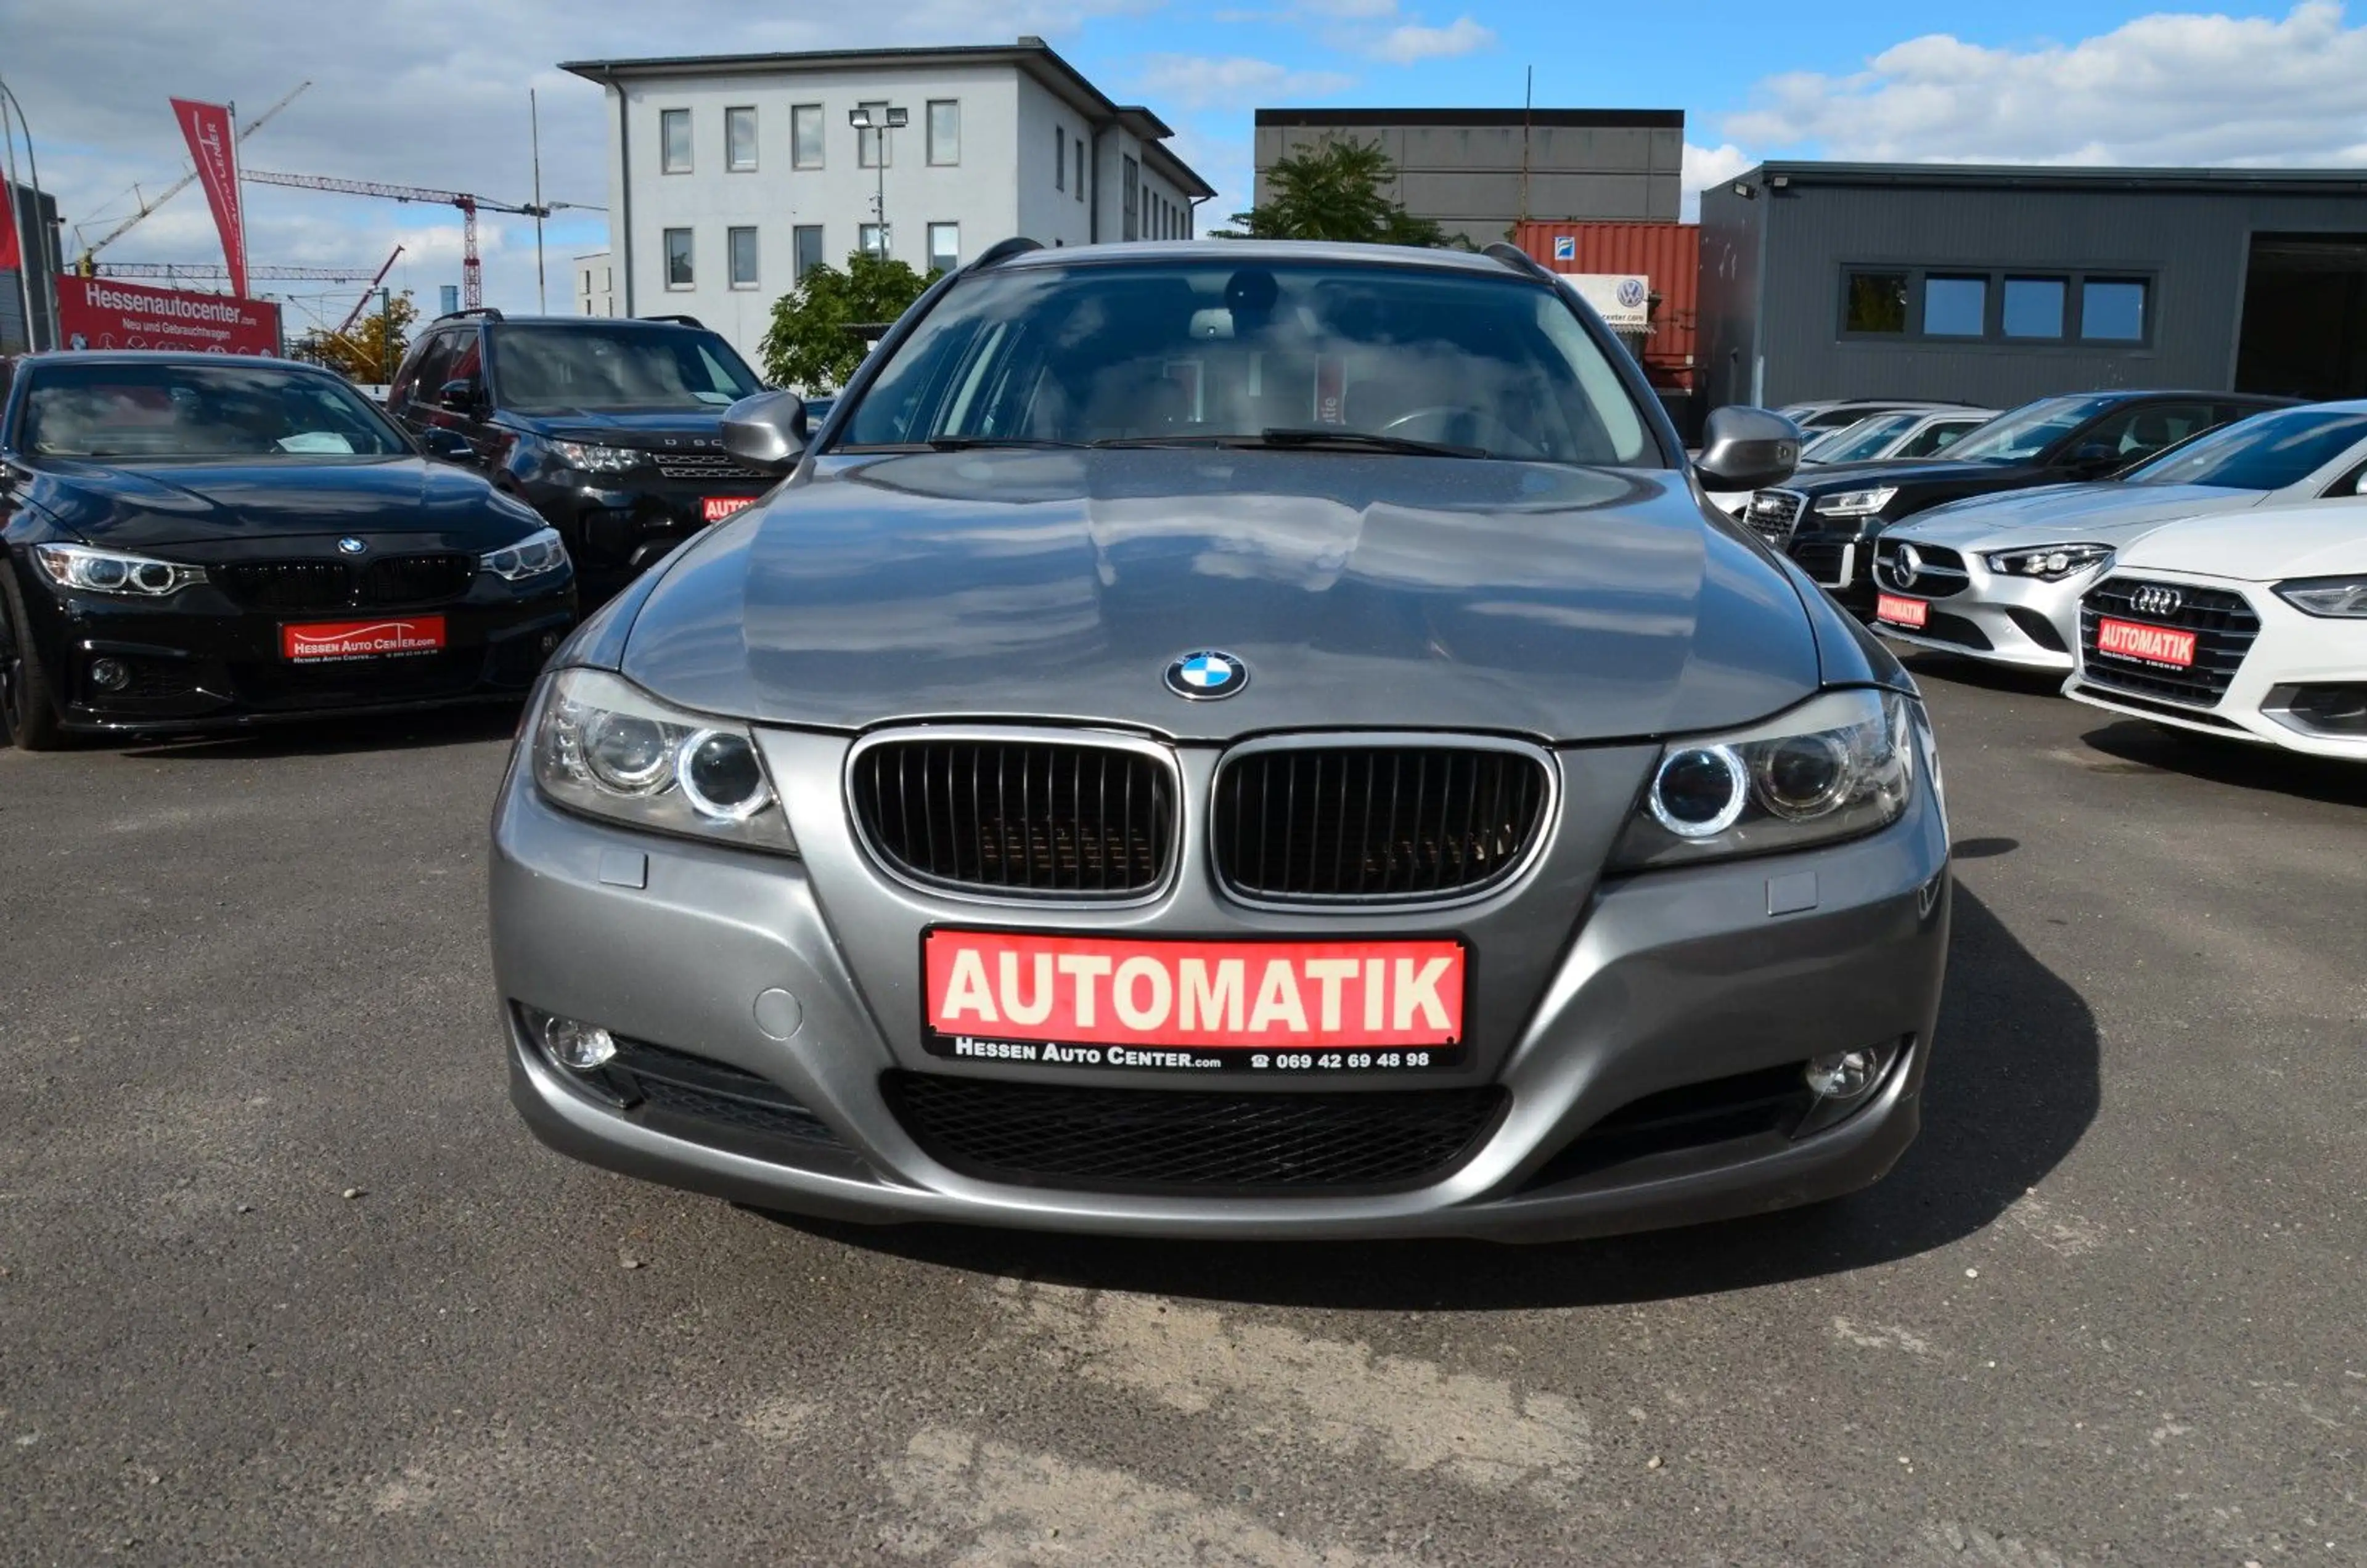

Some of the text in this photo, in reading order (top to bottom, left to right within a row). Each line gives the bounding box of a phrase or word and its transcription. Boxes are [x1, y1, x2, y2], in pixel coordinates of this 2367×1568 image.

[123, 318, 231, 341] Neu und Gebrauchtwagen
[295, 637, 435, 655] HESSEN AUTO CENTER.com
[2099, 623, 2194, 662] AUTOMATIK
[941, 949, 1460, 1032] AUTOMATIK
[956, 1037, 1429, 1069] HESSEN AUTO CENTER.com 069 42 69 48 98
